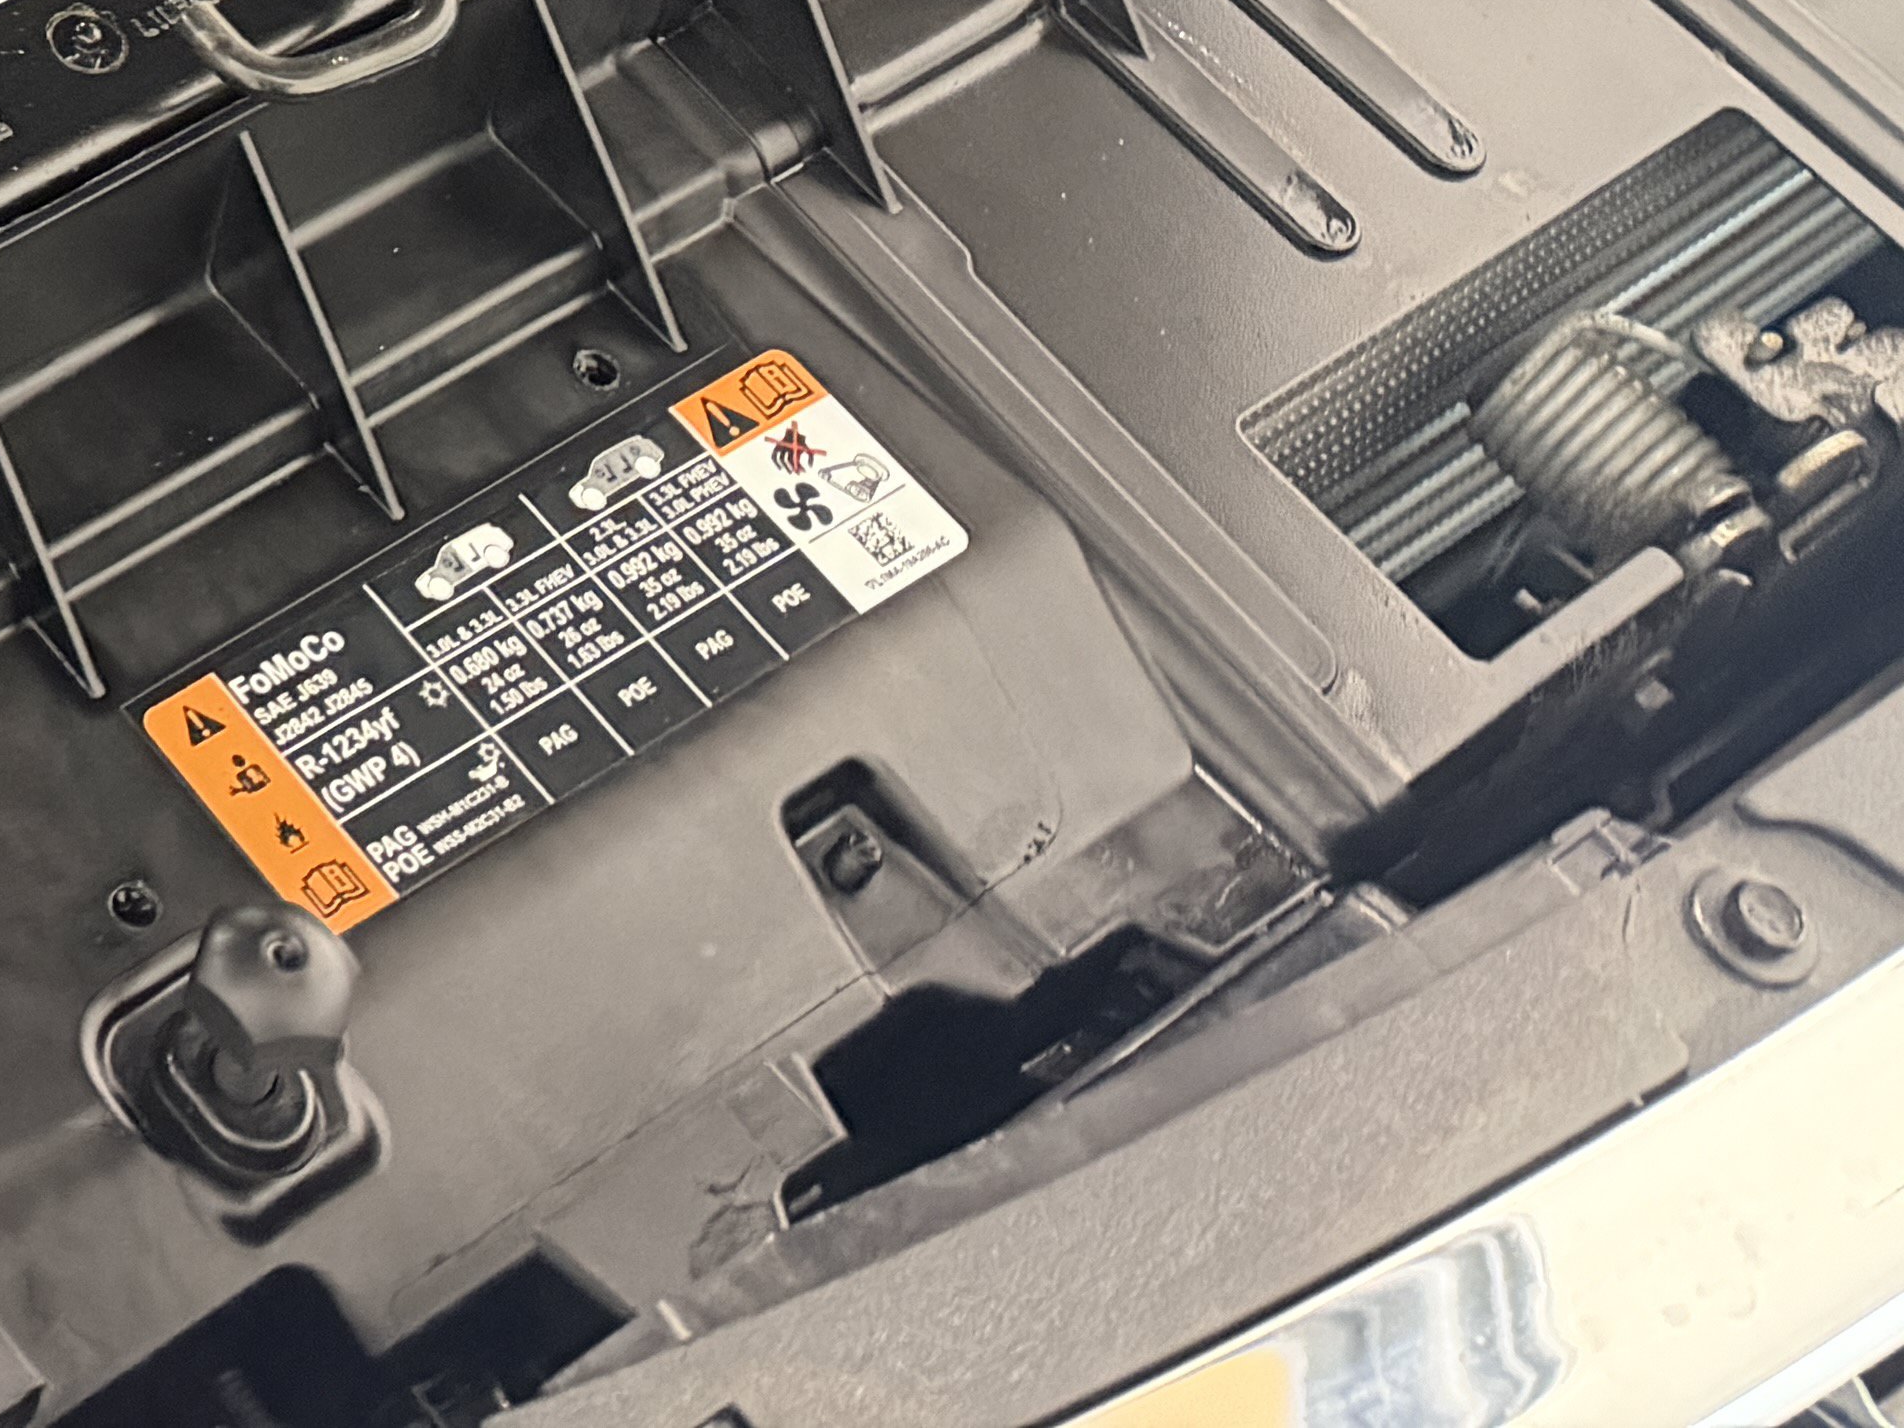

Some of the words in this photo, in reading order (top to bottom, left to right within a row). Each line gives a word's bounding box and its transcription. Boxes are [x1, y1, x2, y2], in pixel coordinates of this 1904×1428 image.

[649, 482, 682, 505] 3.3L
[677, 459, 716, 488] FHEV
[661, 496, 695, 519] 3.0L
[689, 471, 729, 502] PHEV
[682, 508, 732, 544] 0.992
[724, 489, 757, 519] kg
[583, 543, 616, 566] 3.0L
[623, 518, 657, 541] 3.3L
[714, 532, 742, 553] 35
[736, 524, 757, 542] oz
[722, 547, 757, 575] 2.19
[750, 537, 779, 557] lbs
[607, 551, 657, 588] 0.992
[649, 538, 683, 562] kg
[638, 576, 662, 598] 35
[660, 567, 682, 586] oz
[505, 588, 539, 612] 3.3L
[533, 563, 574, 598] FHEV
[646, 592, 681, 620] 2.19
[675, 581, 704, 602] lbs
[771, 582, 810, 612] POE
[426, 634, 460, 658] 3.0L
[469, 609, 503, 633] 3.3L
[526, 600, 573, 638] 0.737
[569, 590, 603, 612] kg
[557, 626, 582, 648] 26
[579, 617, 601, 636] oz
[449, 646, 499, 684] 0.680
[493, 635, 527, 657] kg
[567, 642, 601, 668] 1.63
[594, 630, 624, 652] lbs
[694, 629, 733, 659] PAG
[229, 631, 344, 703] FoMoCo
[480, 672, 505, 694] 24
[503, 663, 525, 682] oz
[253, 691, 297, 724] SAE
[296, 668, 337, 701] J639
[489, 687, 524, 714] 1.50
[518, 676, 548, 698] lbs
[617, 676, 656, 706] POE
[274, 706, 324, 745] J2842
[295, 707, 398, 778] R-1234yf
[538, 723, 577, 755] PAG
[321, 756, 386, 812] (GWP
[390, 741, 420, 766] 4)
[366, 825, 417, 863] PAG
[382, 842, 434, 882] POE
